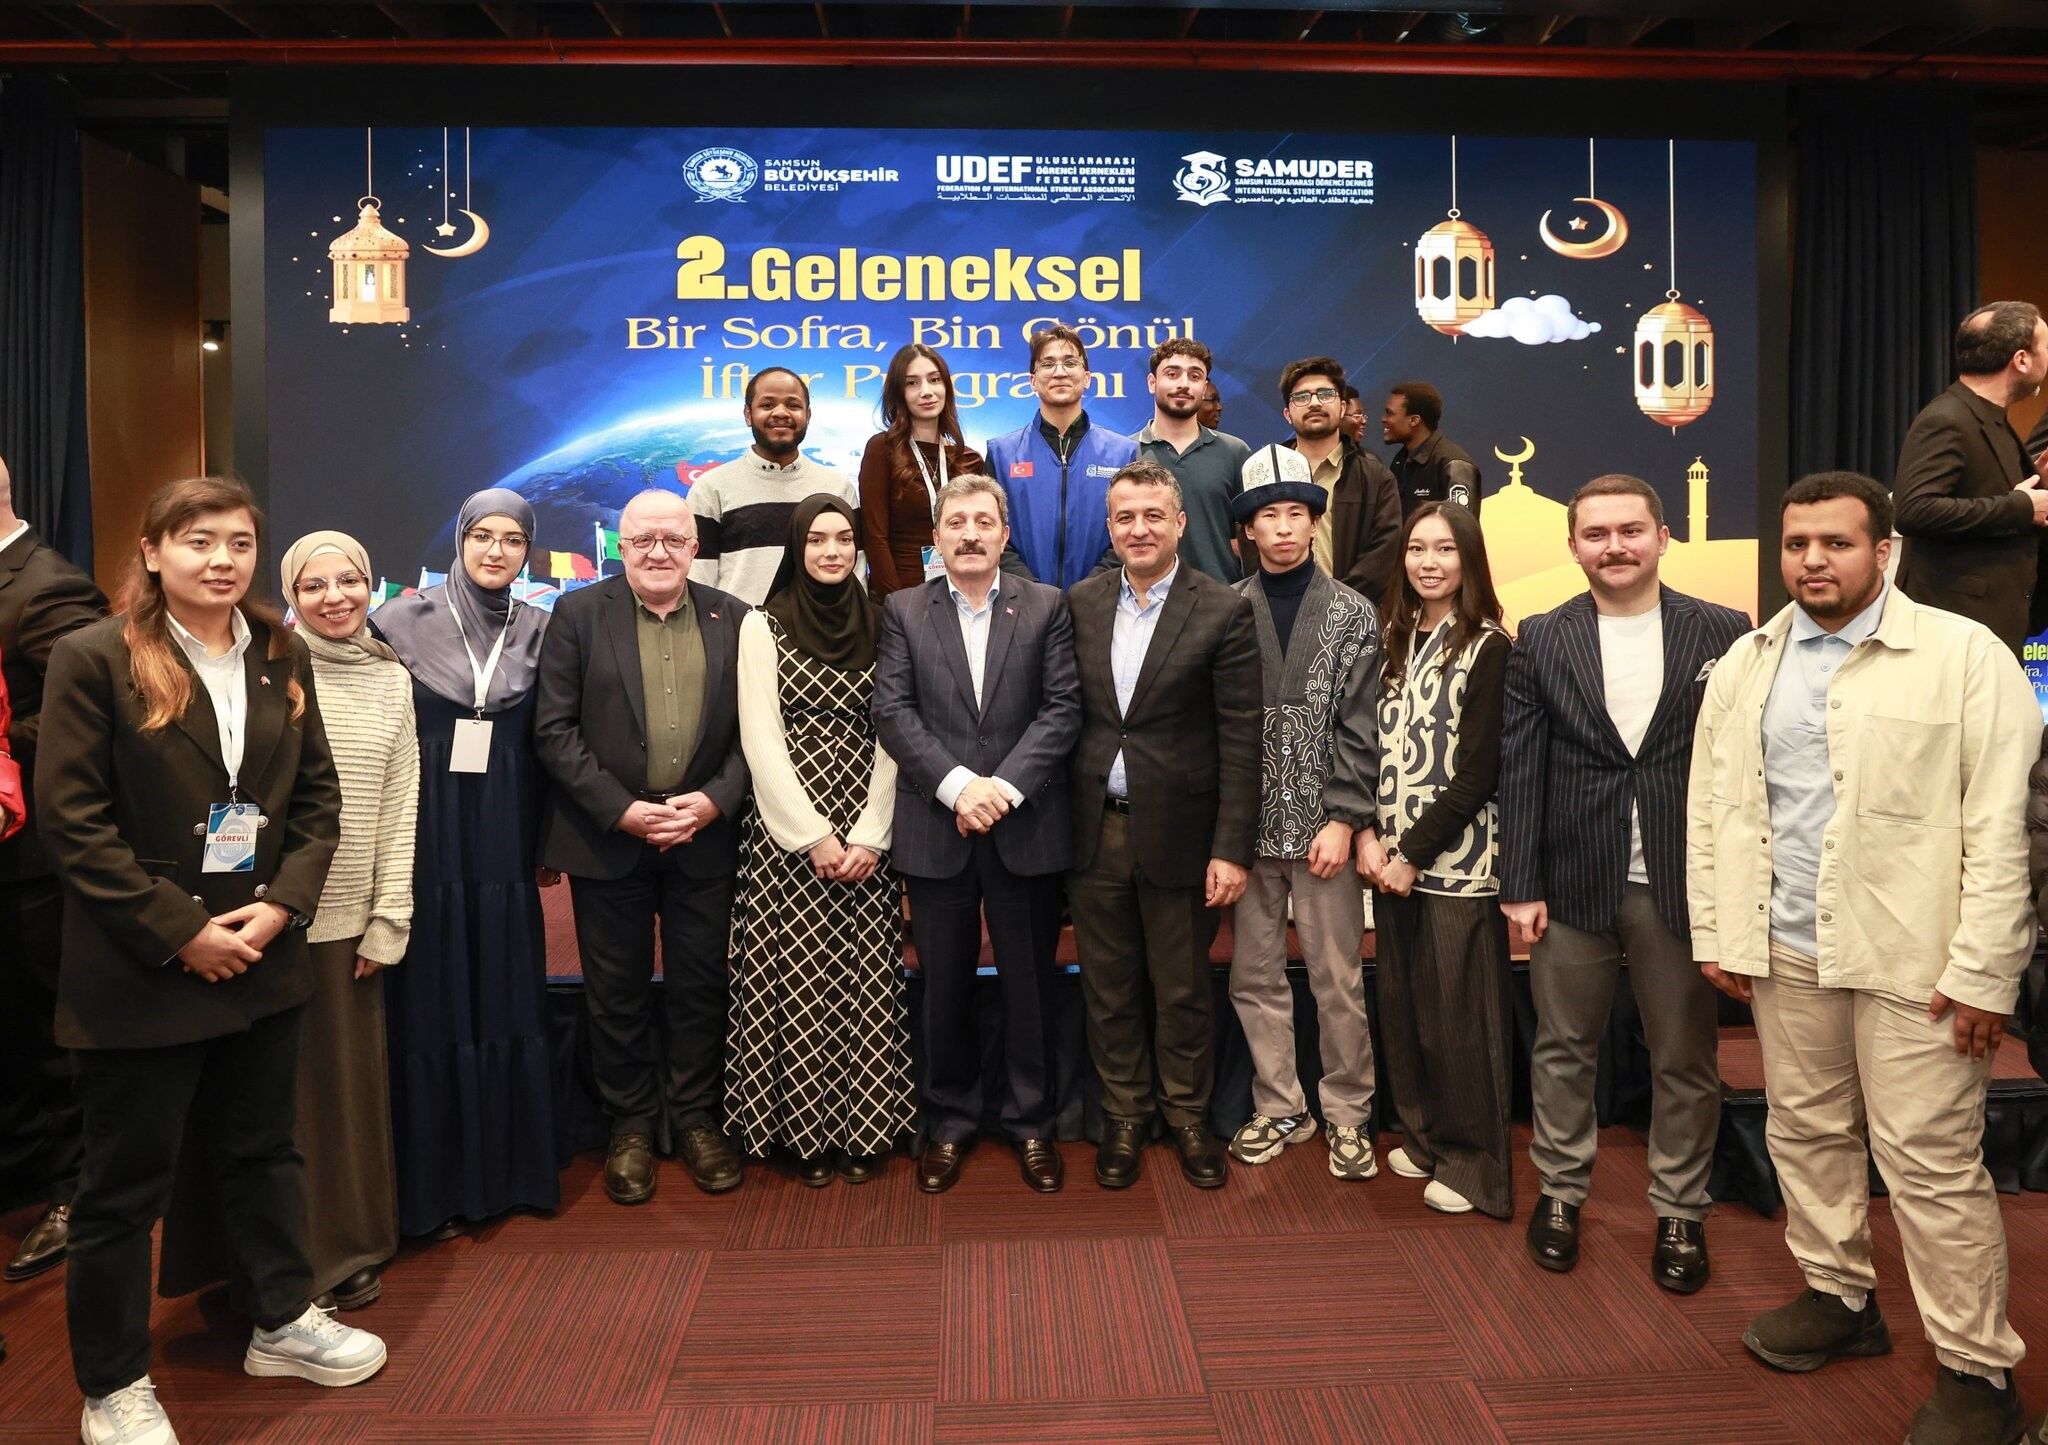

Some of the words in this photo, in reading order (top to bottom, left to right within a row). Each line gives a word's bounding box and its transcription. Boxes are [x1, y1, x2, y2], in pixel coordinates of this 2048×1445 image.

[764, 159, 820, 167] SAMSUN
[1036, 156, 1135, 165] ULUSLARARASI
[936, 155, 1033, 183] UDEF
[1036, 165, 1077, 175] ÖĞRENCİ
[1079, 166, 1136, 176] DERNEKLERİ
[1234, 159, 1374, 178] SAMUDER
[764, 167, 900, 184] BÜYÜKŞEHİR
[1036, 176, 1135, 185] FEDERASYONU
[764, 182, 839, 192] BELEDİYESİ
[1265, 178, 1314, 186] ULUSLARARASI
[1235, 187, 1291, 195] INTERNATIONAL
[1293, 187, 1325, 195] STUDENT
[1327, 188, 1374, 196] ASSOCIATION
[624, 315, 707, 350] Bir
[722, 315, 888, 352] Sofra,
[910, 315, 1003, 349] Bin
[700, 356, 824, 399] İftr
[843, 364, 1128, 409] Pgraı
[215, 834, 249, 842] GÖREVLİ
